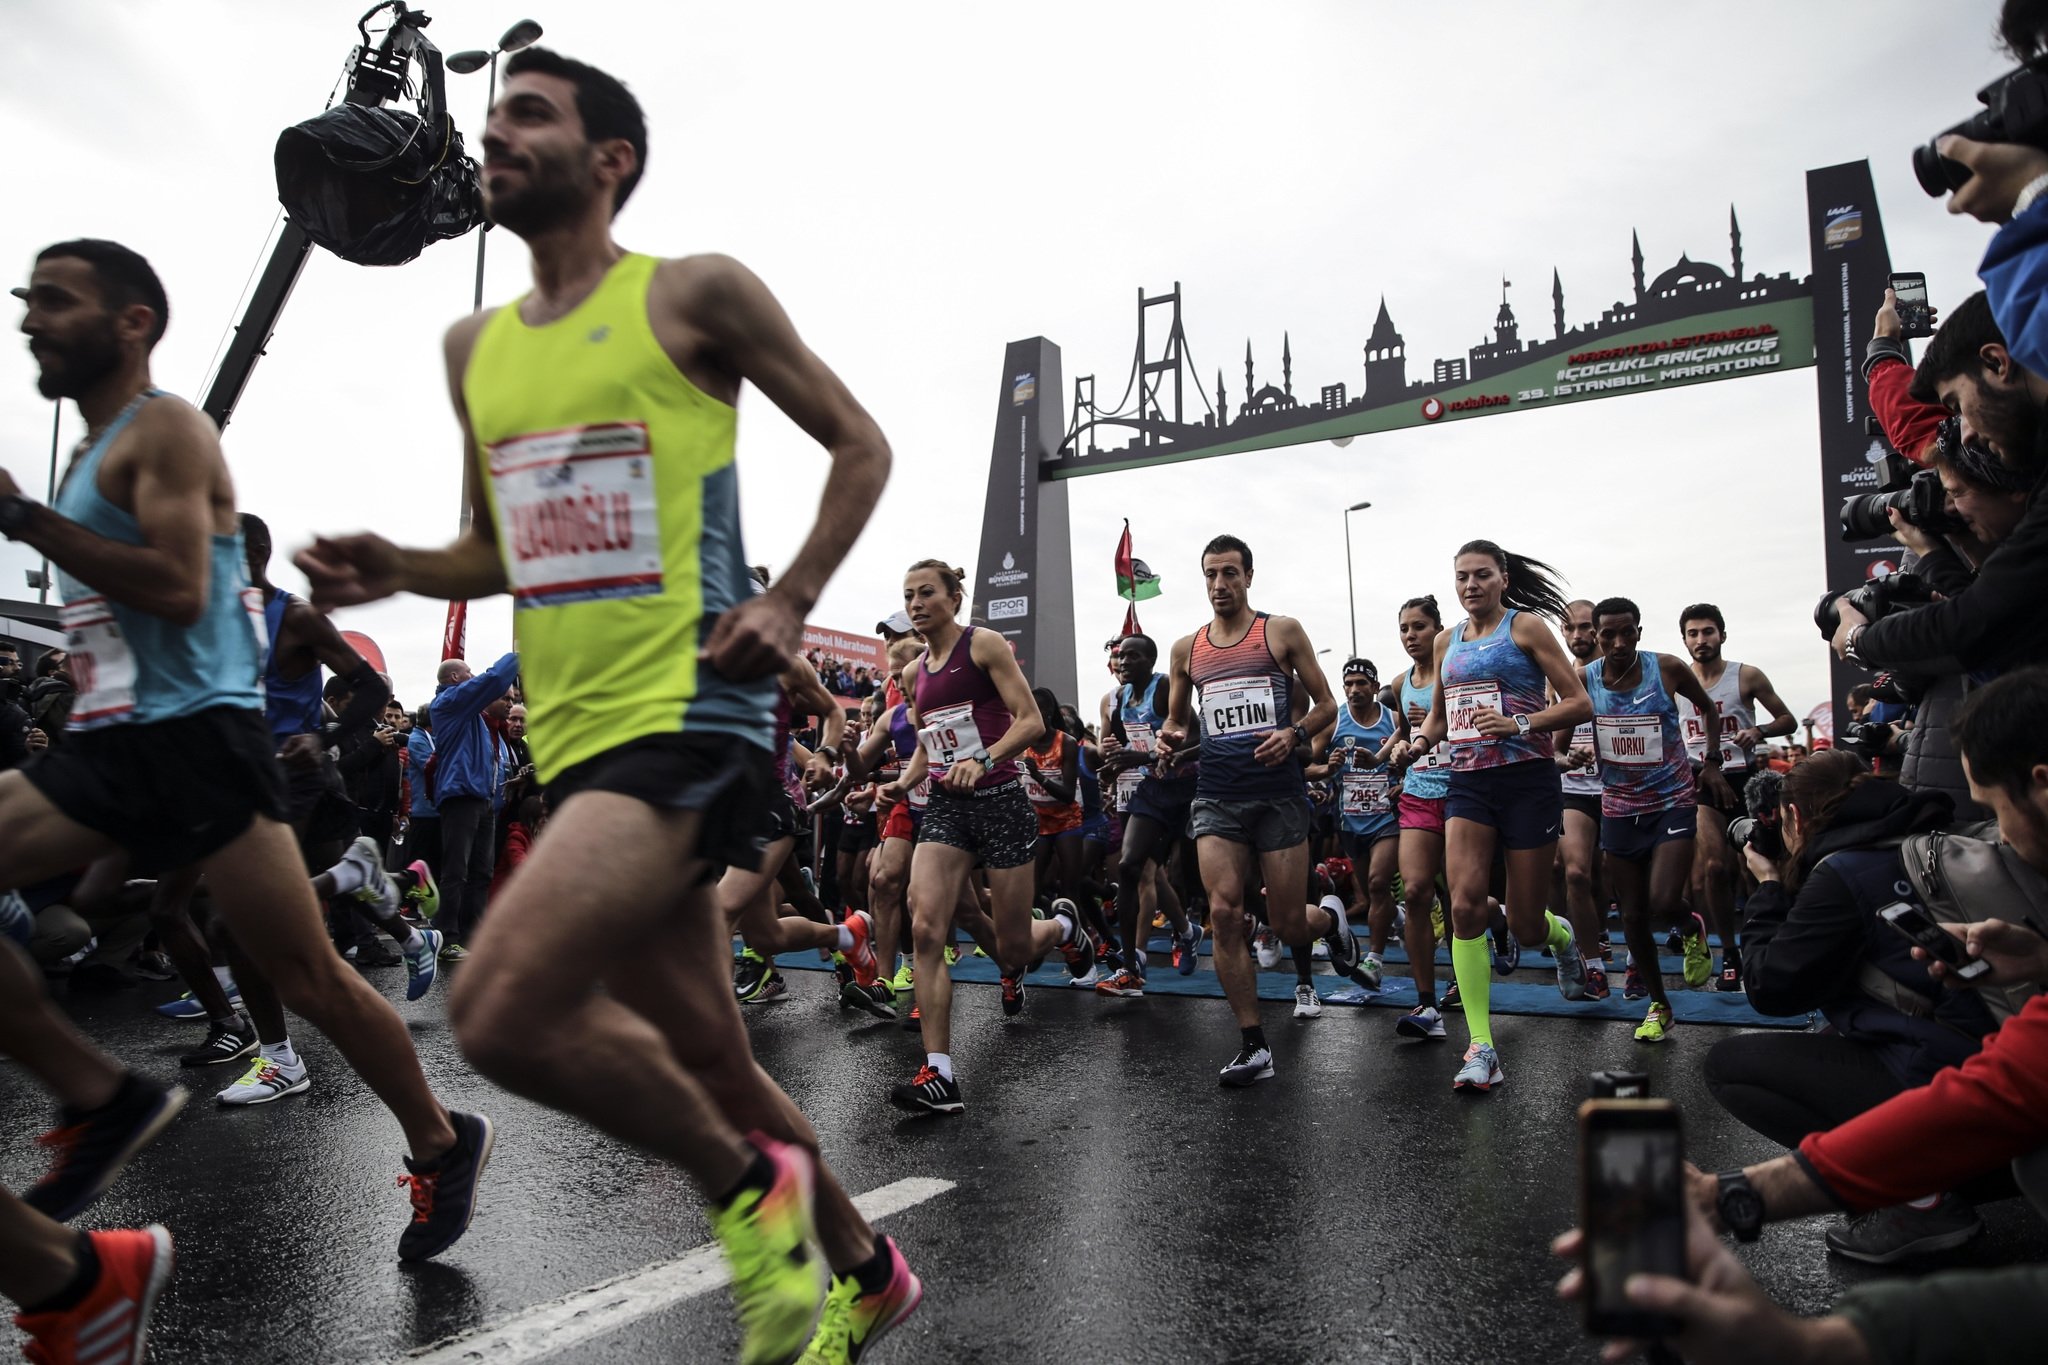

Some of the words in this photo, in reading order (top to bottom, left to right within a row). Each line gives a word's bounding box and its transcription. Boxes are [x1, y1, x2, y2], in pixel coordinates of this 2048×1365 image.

[1447, 394, 1511, 412] vodafone
[1518, 388, 1549, 401] 39.
[1659, 353, 1780, 382] MARATONU
[1841, 470, 1877, 483] BÜYÜ
[991, 599, 1025, 611] SPOR
[802, 631, 834, 647] tanbul
[834, 635, 877, 656] Maratonu
[1213, 698, 1268, 735] ÇETİN
[929, 729, 958, 751] 119
[1611, 736, 1646, 756] WORKU
[1699, 749, 1732, 764] 18
[974, 786, 1000, 798] NIKE
